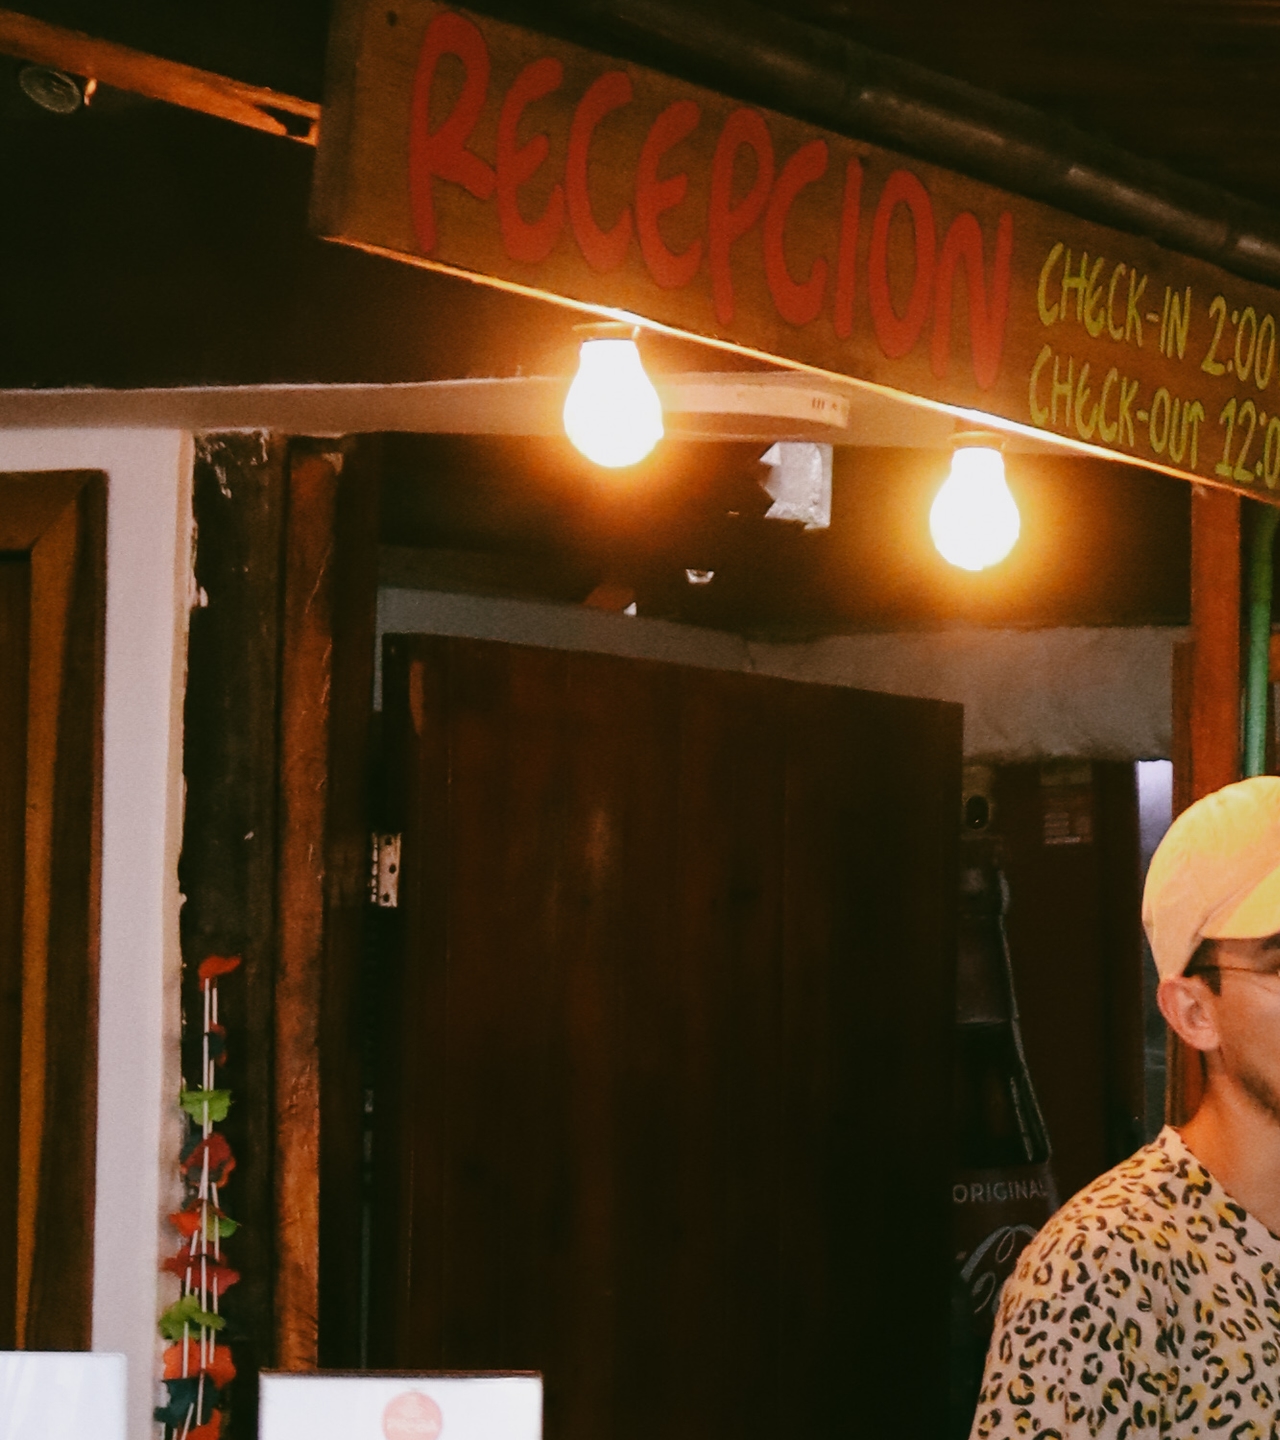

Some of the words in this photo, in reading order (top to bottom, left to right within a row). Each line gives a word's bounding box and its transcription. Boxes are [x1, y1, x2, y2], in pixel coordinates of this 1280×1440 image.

[408, 11, 1014, 391] RECEPCION
[1037, 242, 1192, 360] CHECK-IN
[1028, 343, 1205, 470] CHECK-OUT
[952, 1179, 1049, 1204] ORIGINAL
